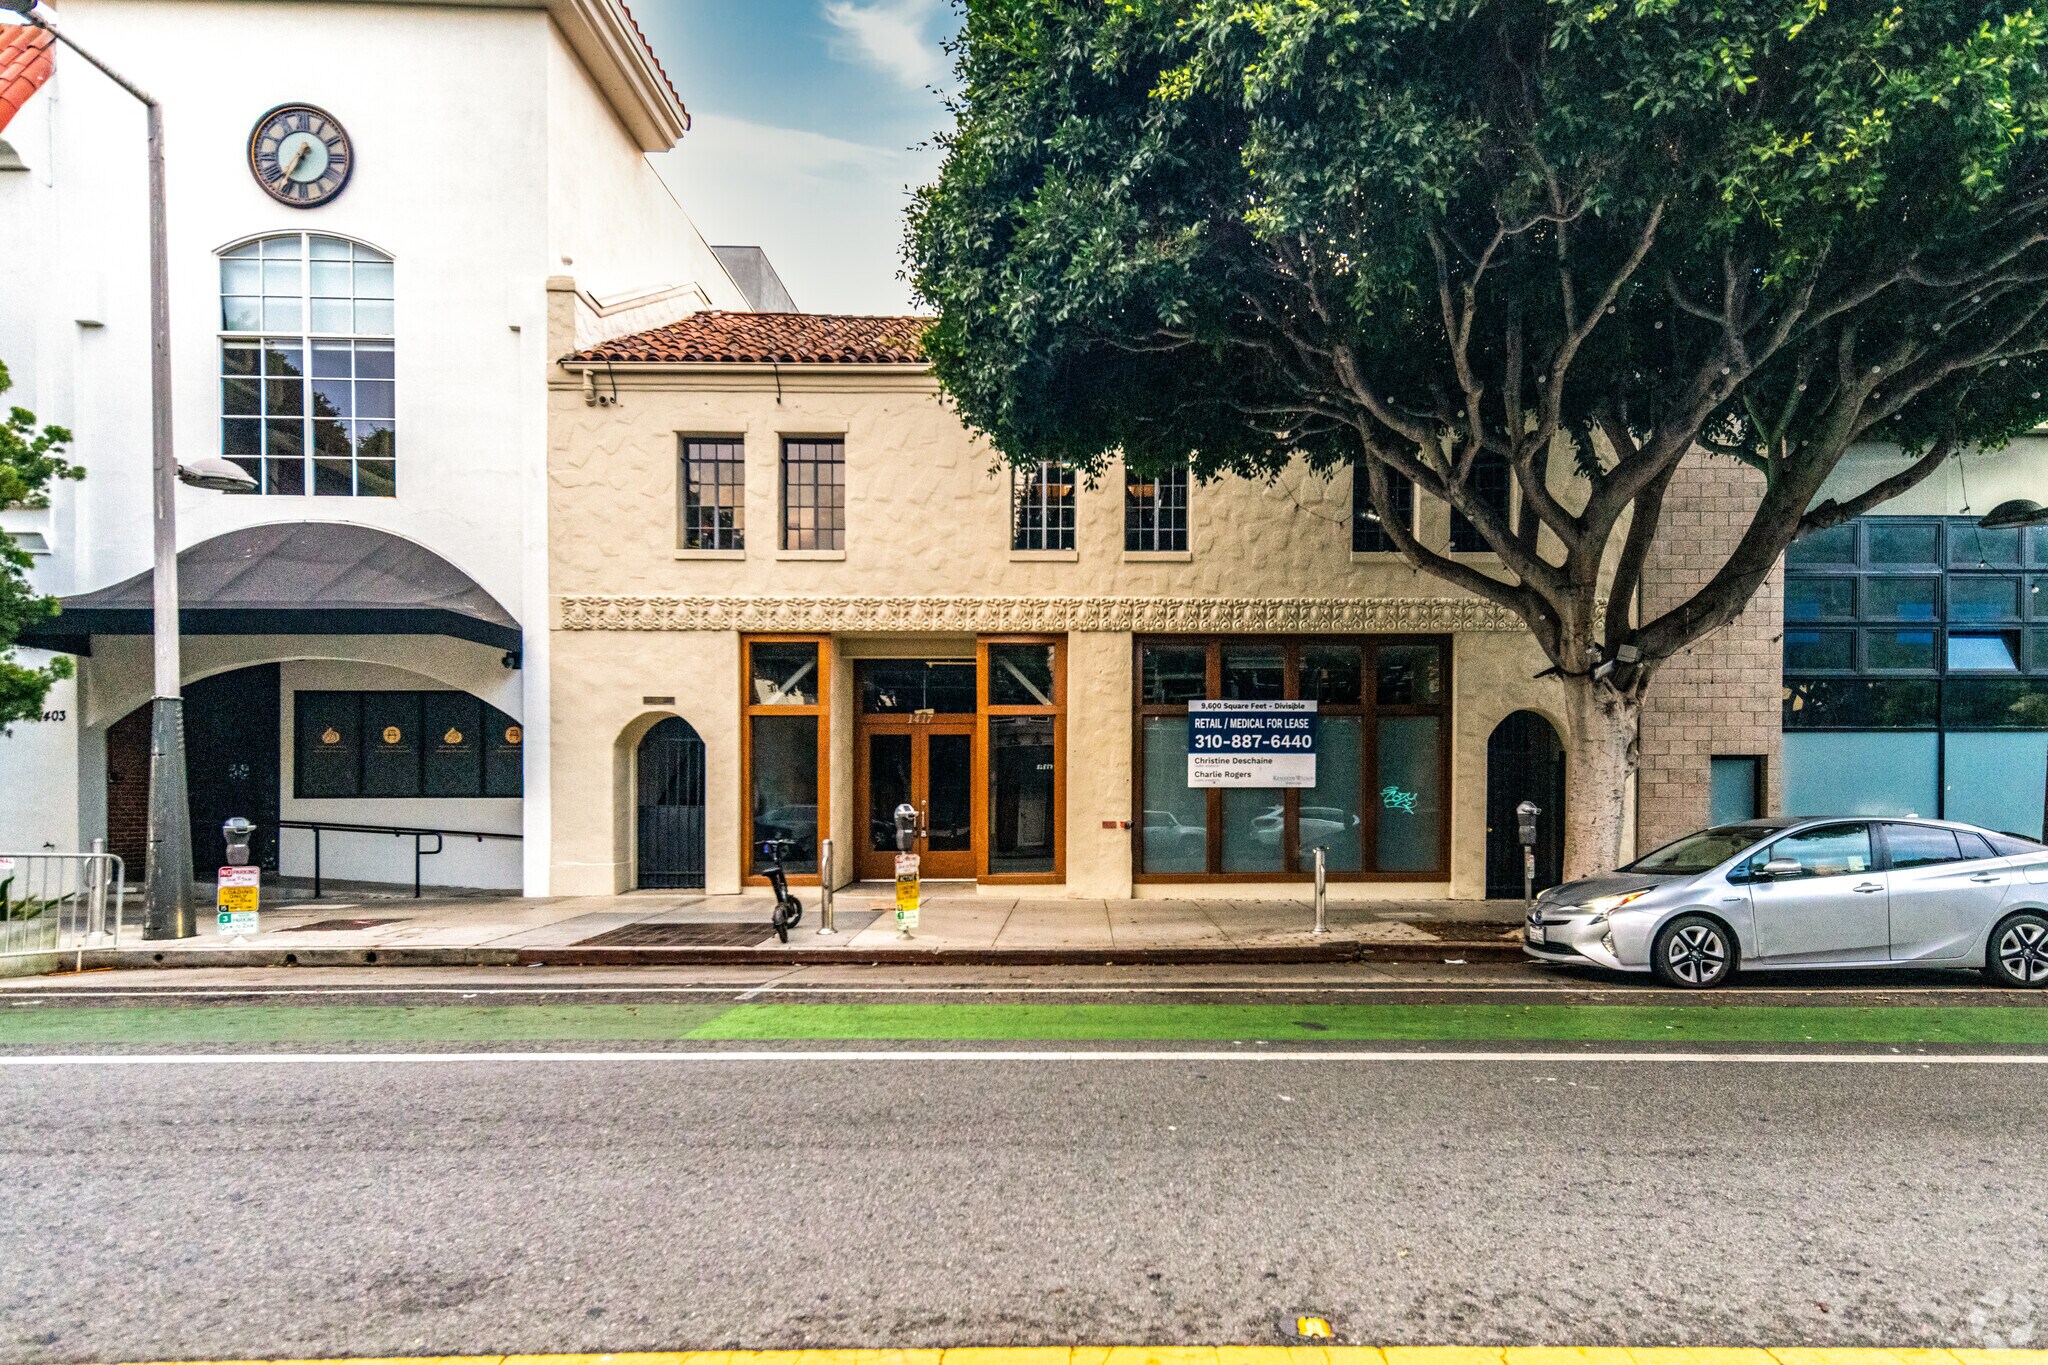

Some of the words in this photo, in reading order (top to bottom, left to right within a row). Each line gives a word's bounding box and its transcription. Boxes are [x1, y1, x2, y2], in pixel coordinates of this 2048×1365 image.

[1201, 702, 1221, 711] 9,600
[1223, 702, 1249, 711] Square
[1274, 702, 1305, 711] Divisible
[907, 714, 934, 724] 1417
[1194, 718, 1222, 729] RETAIL
[1223, 717, 1229, 730] /
[1229, 718, 1265, 729] MEDICAL
[1266, 718, 1283, 729] FOR
[1284, 718, 1309, 729] LEASE
[1194, 734, 1312, 749] 310-887-6440
[1194, 757, 1230, 765] Christine
[1232, 757, 1273, 765] Deschaine
[1224, 771, 1252, 780] Rogers
